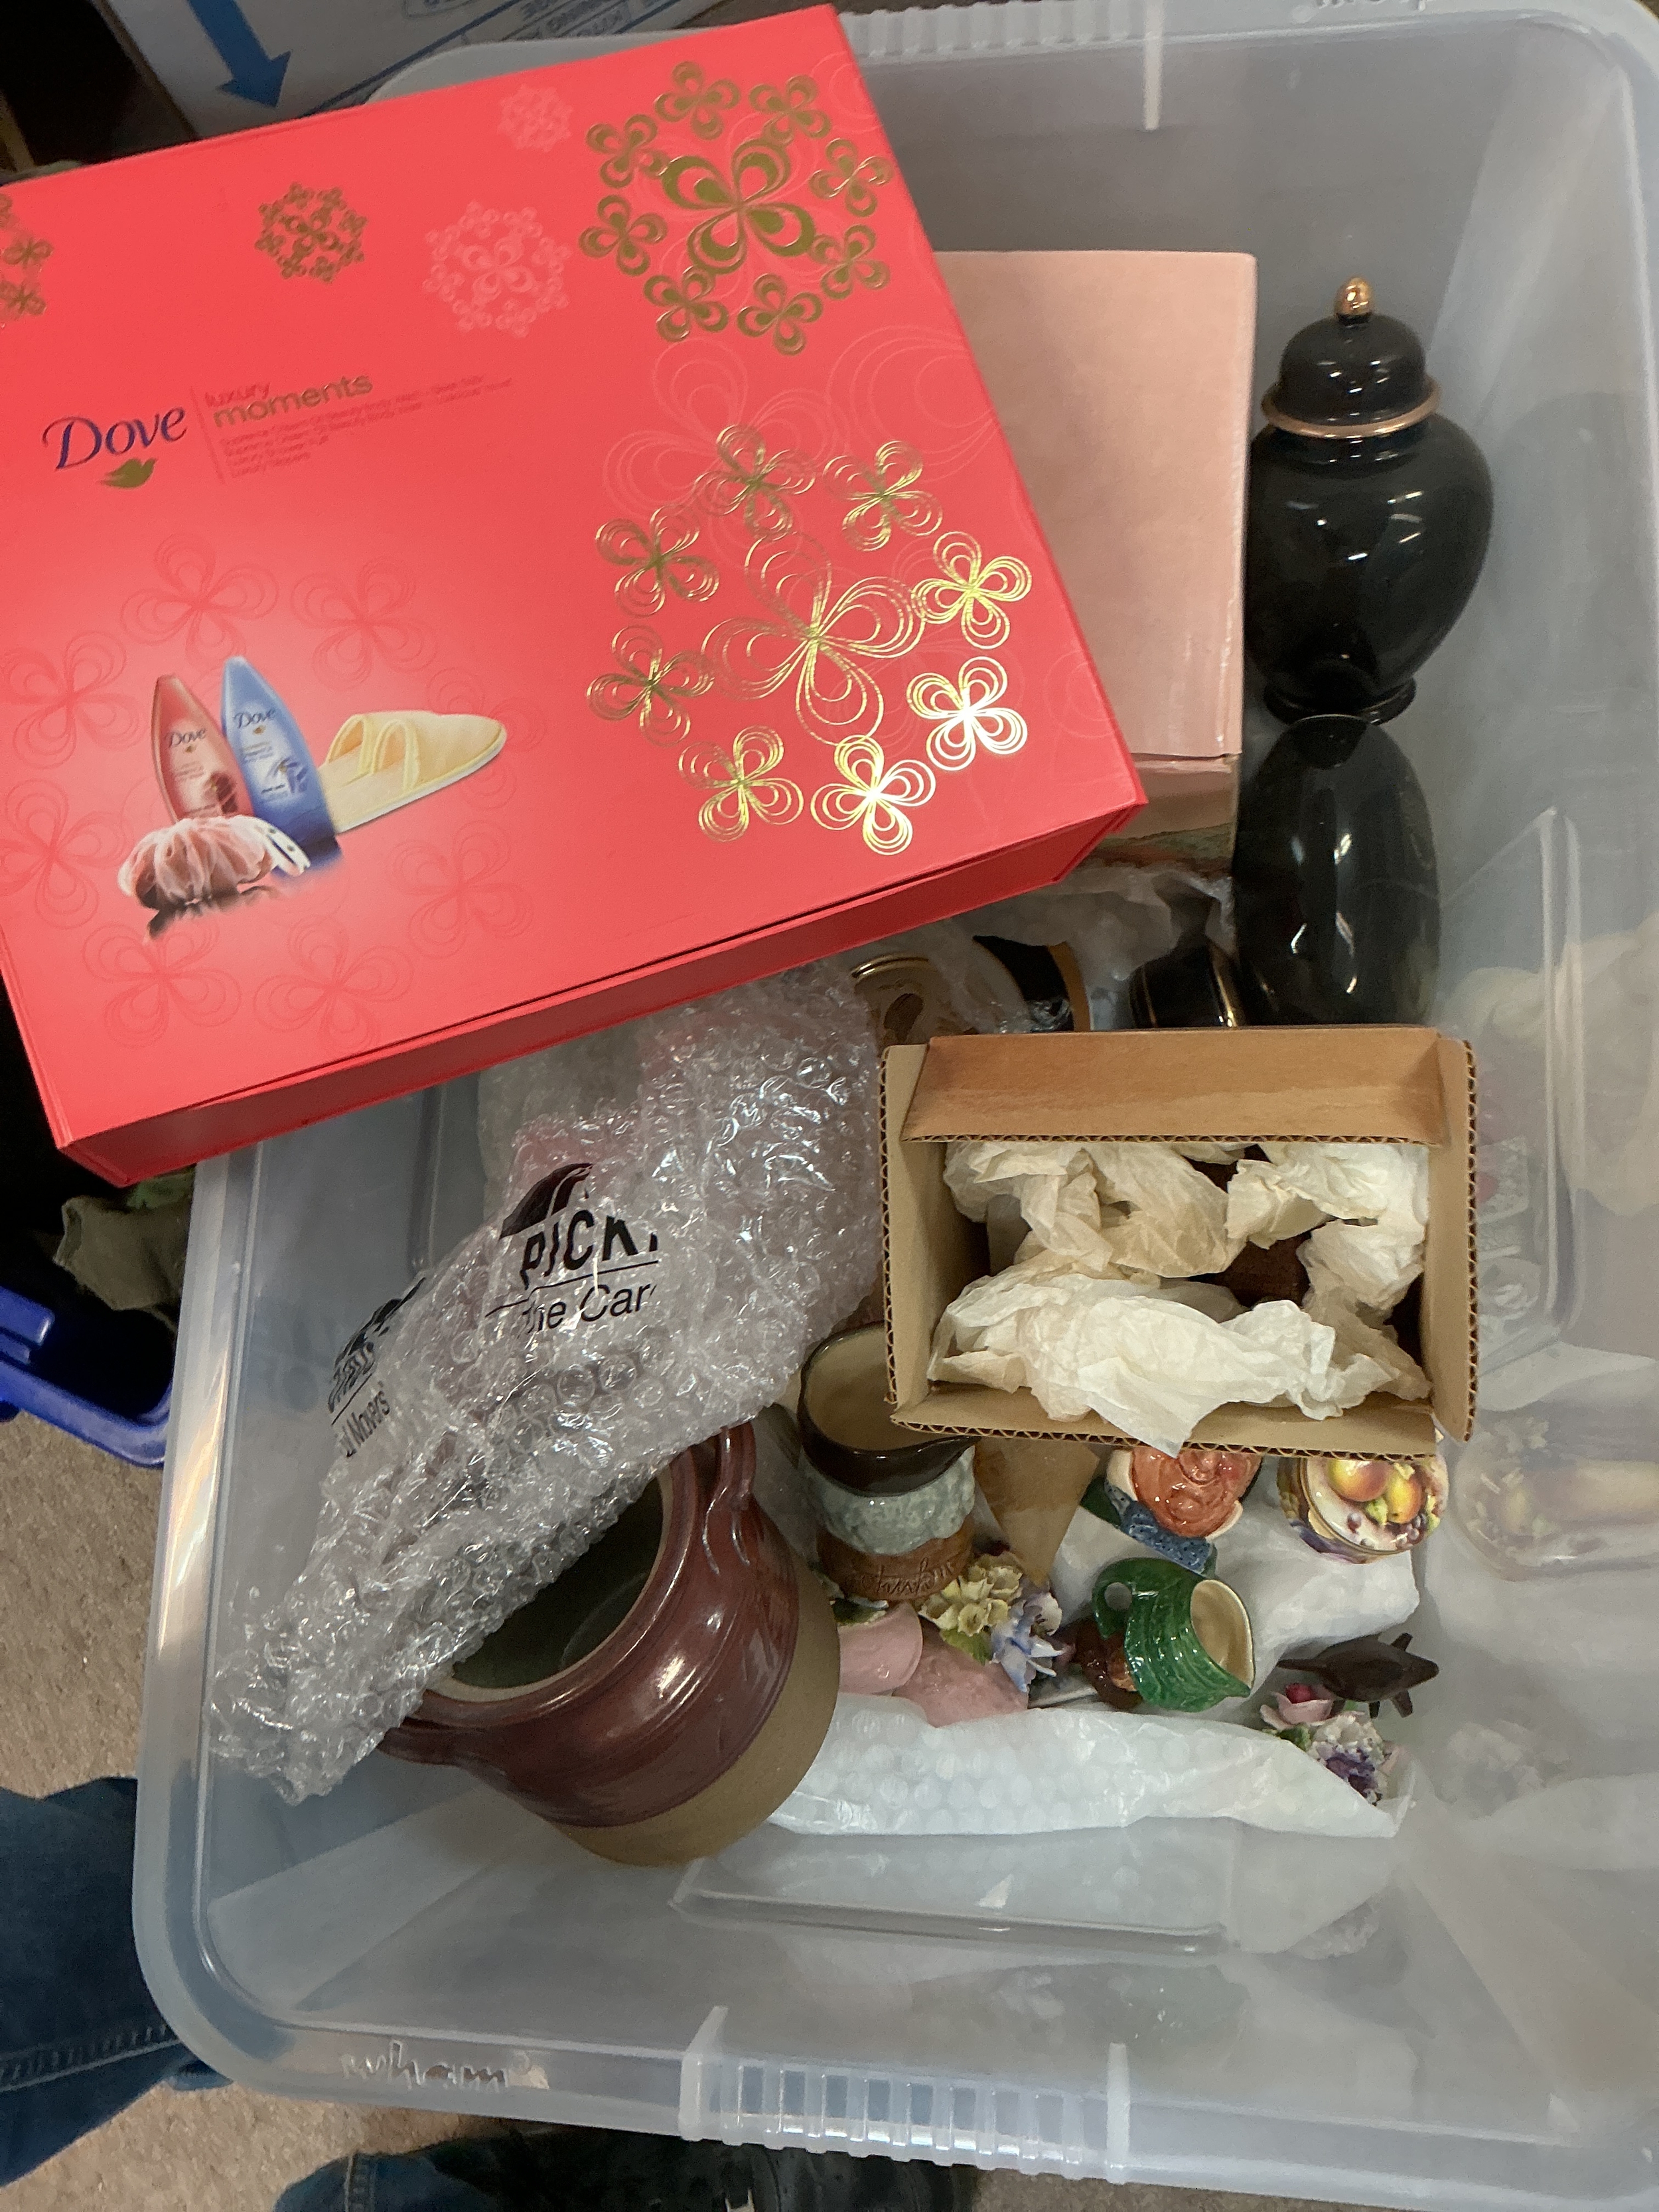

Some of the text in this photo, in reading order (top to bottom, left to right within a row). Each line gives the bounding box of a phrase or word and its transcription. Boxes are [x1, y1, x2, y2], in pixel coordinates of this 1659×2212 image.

[213, 375, 373, 427] moments
[41, 406, 188, 471] Dove
[233, 708, 276, 729] Dove
[165, 727, 207, 749] Dove
[579, 1284, 657, 1322] Car
